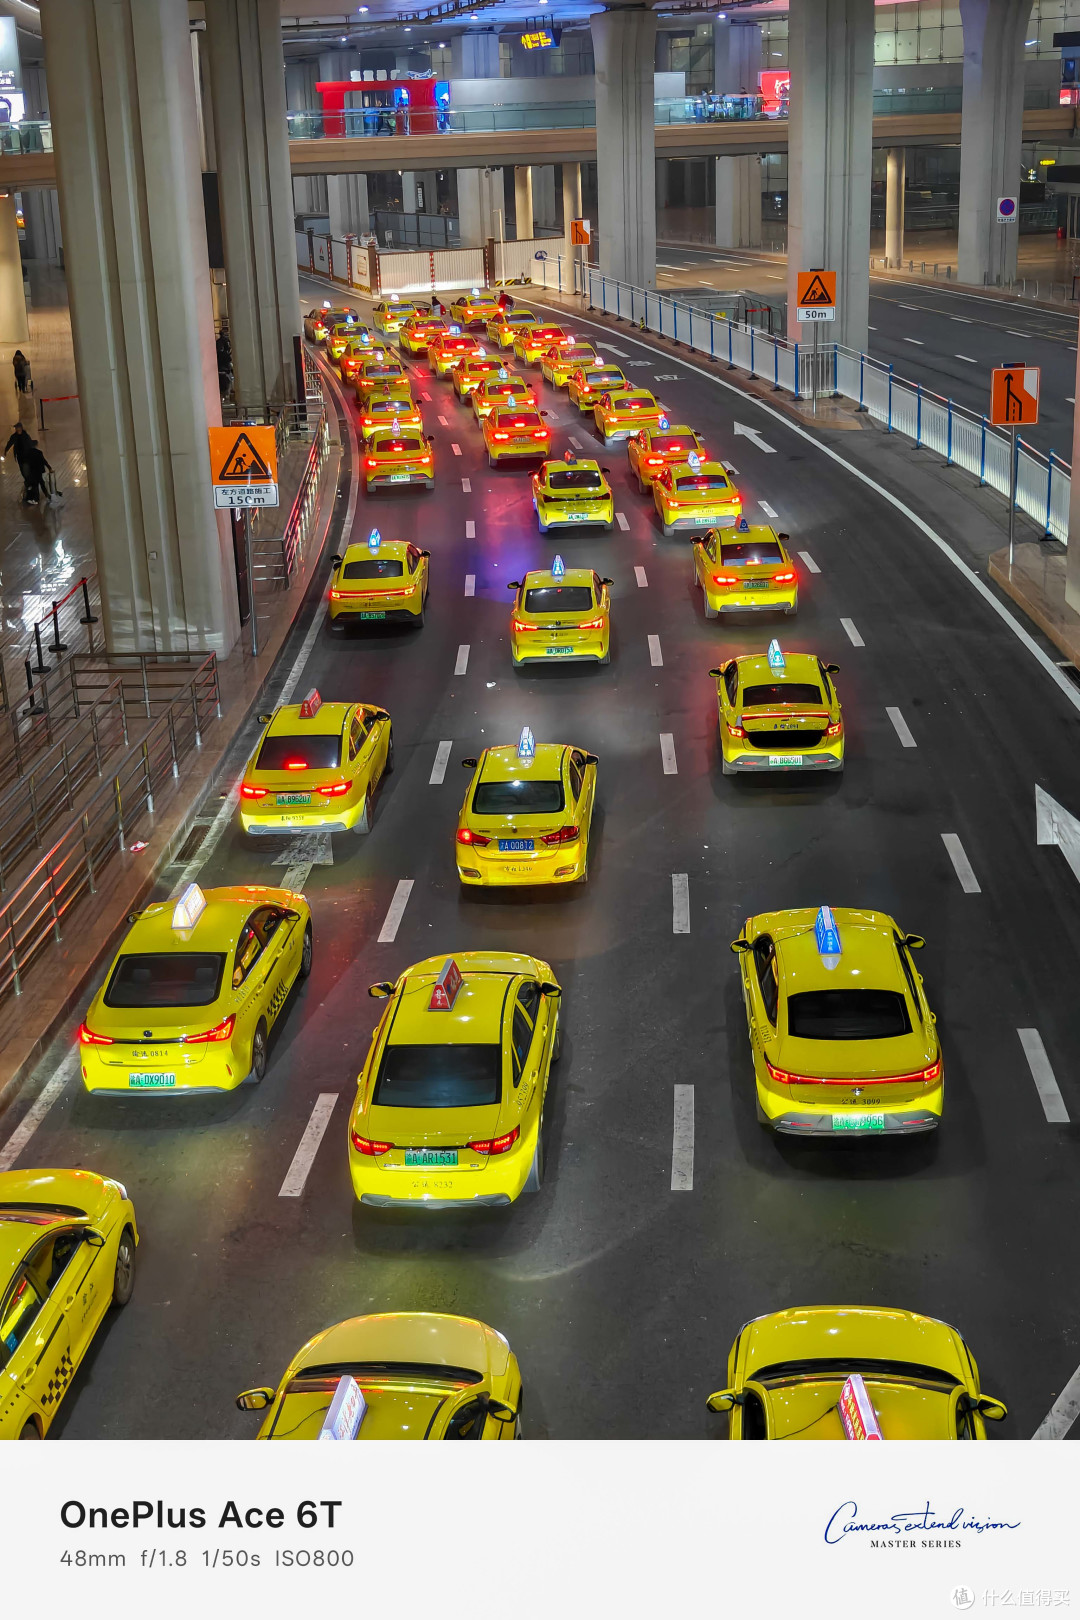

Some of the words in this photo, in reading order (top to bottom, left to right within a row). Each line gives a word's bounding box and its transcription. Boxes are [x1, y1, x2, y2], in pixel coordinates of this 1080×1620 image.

[805, 310, 827, 319] 50m
[221, 487, 271, 496] 左方道路施工
[228, 496, 265, 505] 150m
[511, 841, 533, 850] 00812
[145, 1075, 175, 1085] DX9010
[422, 1152, 456, 1164] AR1531
